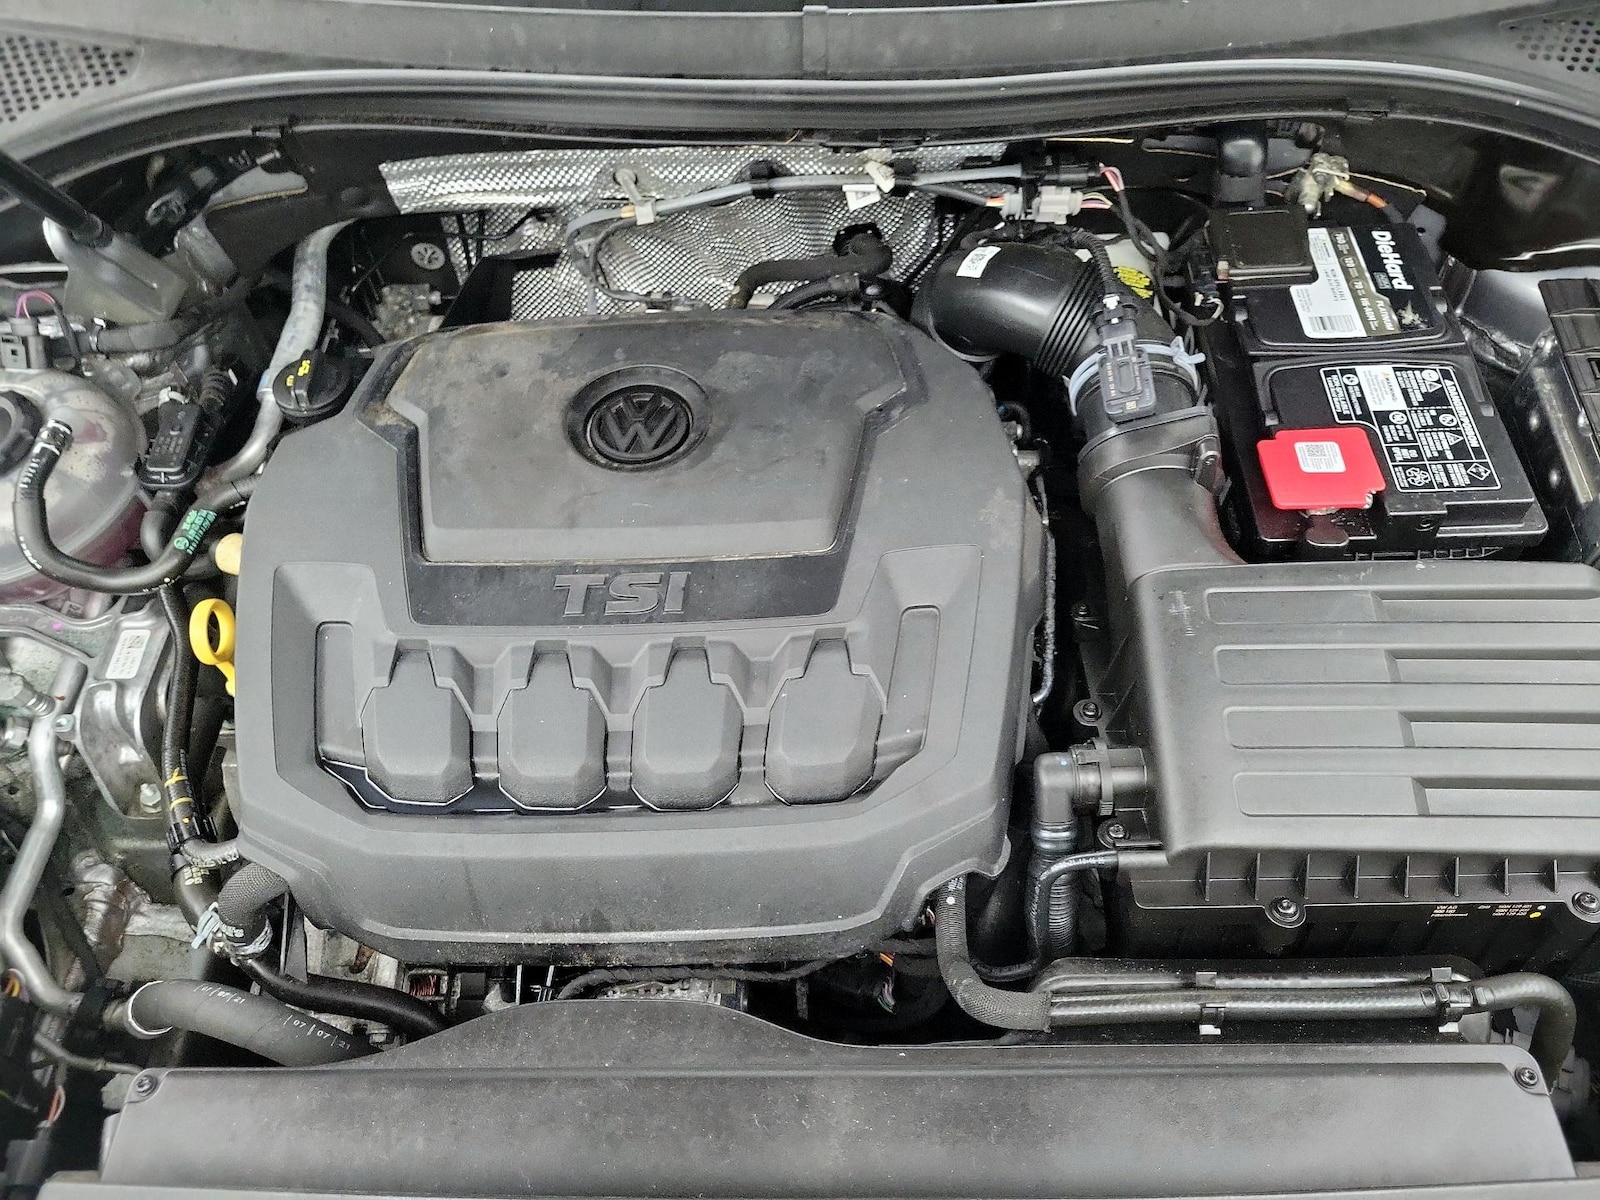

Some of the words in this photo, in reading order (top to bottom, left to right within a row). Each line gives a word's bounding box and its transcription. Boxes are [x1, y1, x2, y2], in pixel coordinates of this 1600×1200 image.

[1371, 230, 1414, 290] DieHard
[1376, 300, 1395, 331] PLATINUM
[553, 572, 691, 617] TSI
